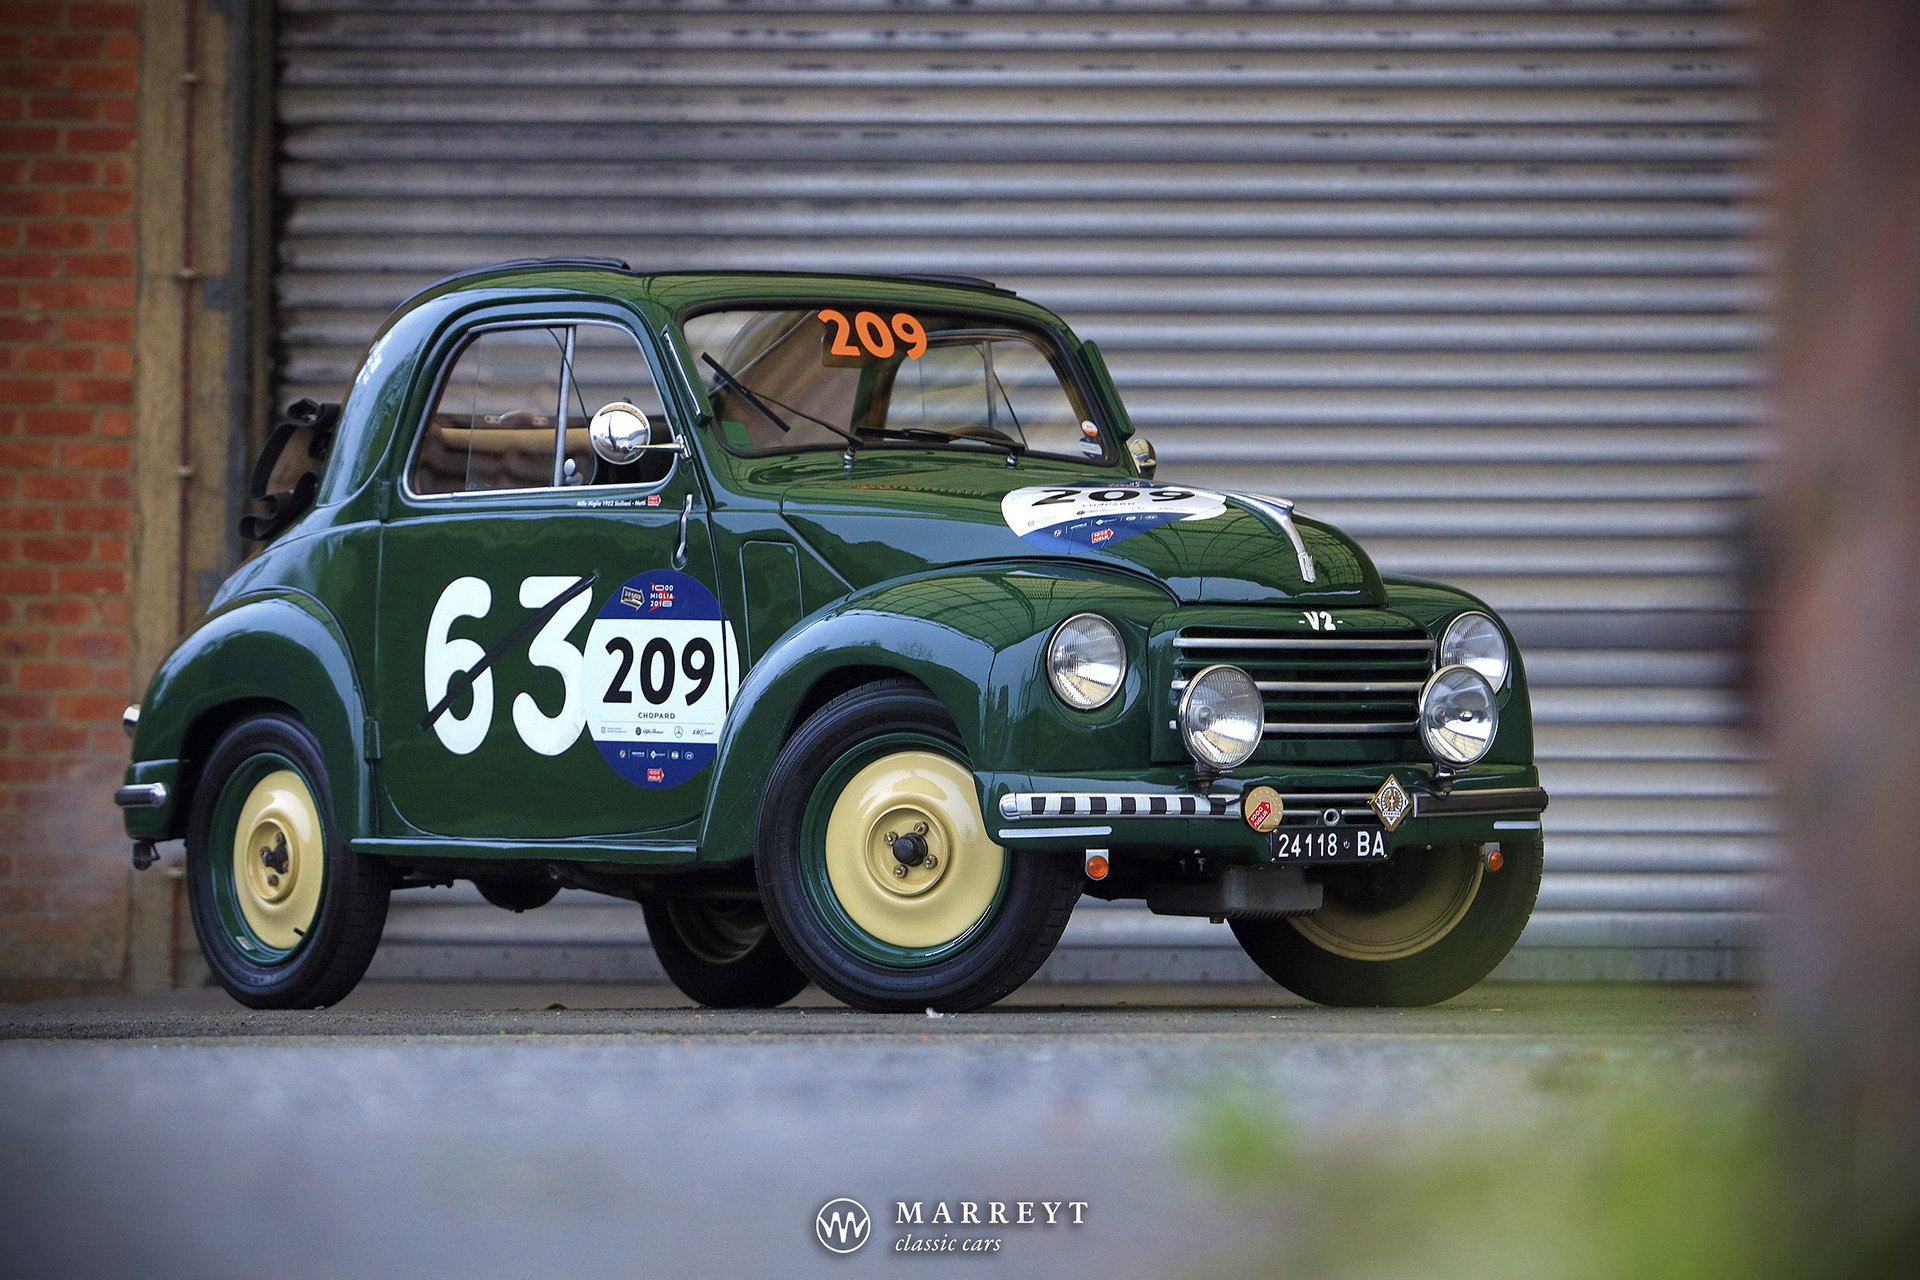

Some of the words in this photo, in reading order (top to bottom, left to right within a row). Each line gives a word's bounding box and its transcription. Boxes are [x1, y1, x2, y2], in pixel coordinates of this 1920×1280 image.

[817, 308, 928, 360] 209
[424, 576, 593, 756] 63
[602, 636, 715, 706] 209
[638, 712, 676, 720] CHOPARD
[1250, 806, 1263, 821] 1000
[1278, 833, 1338, 858] 24118
[1357, 831, 1385, 857] BA
